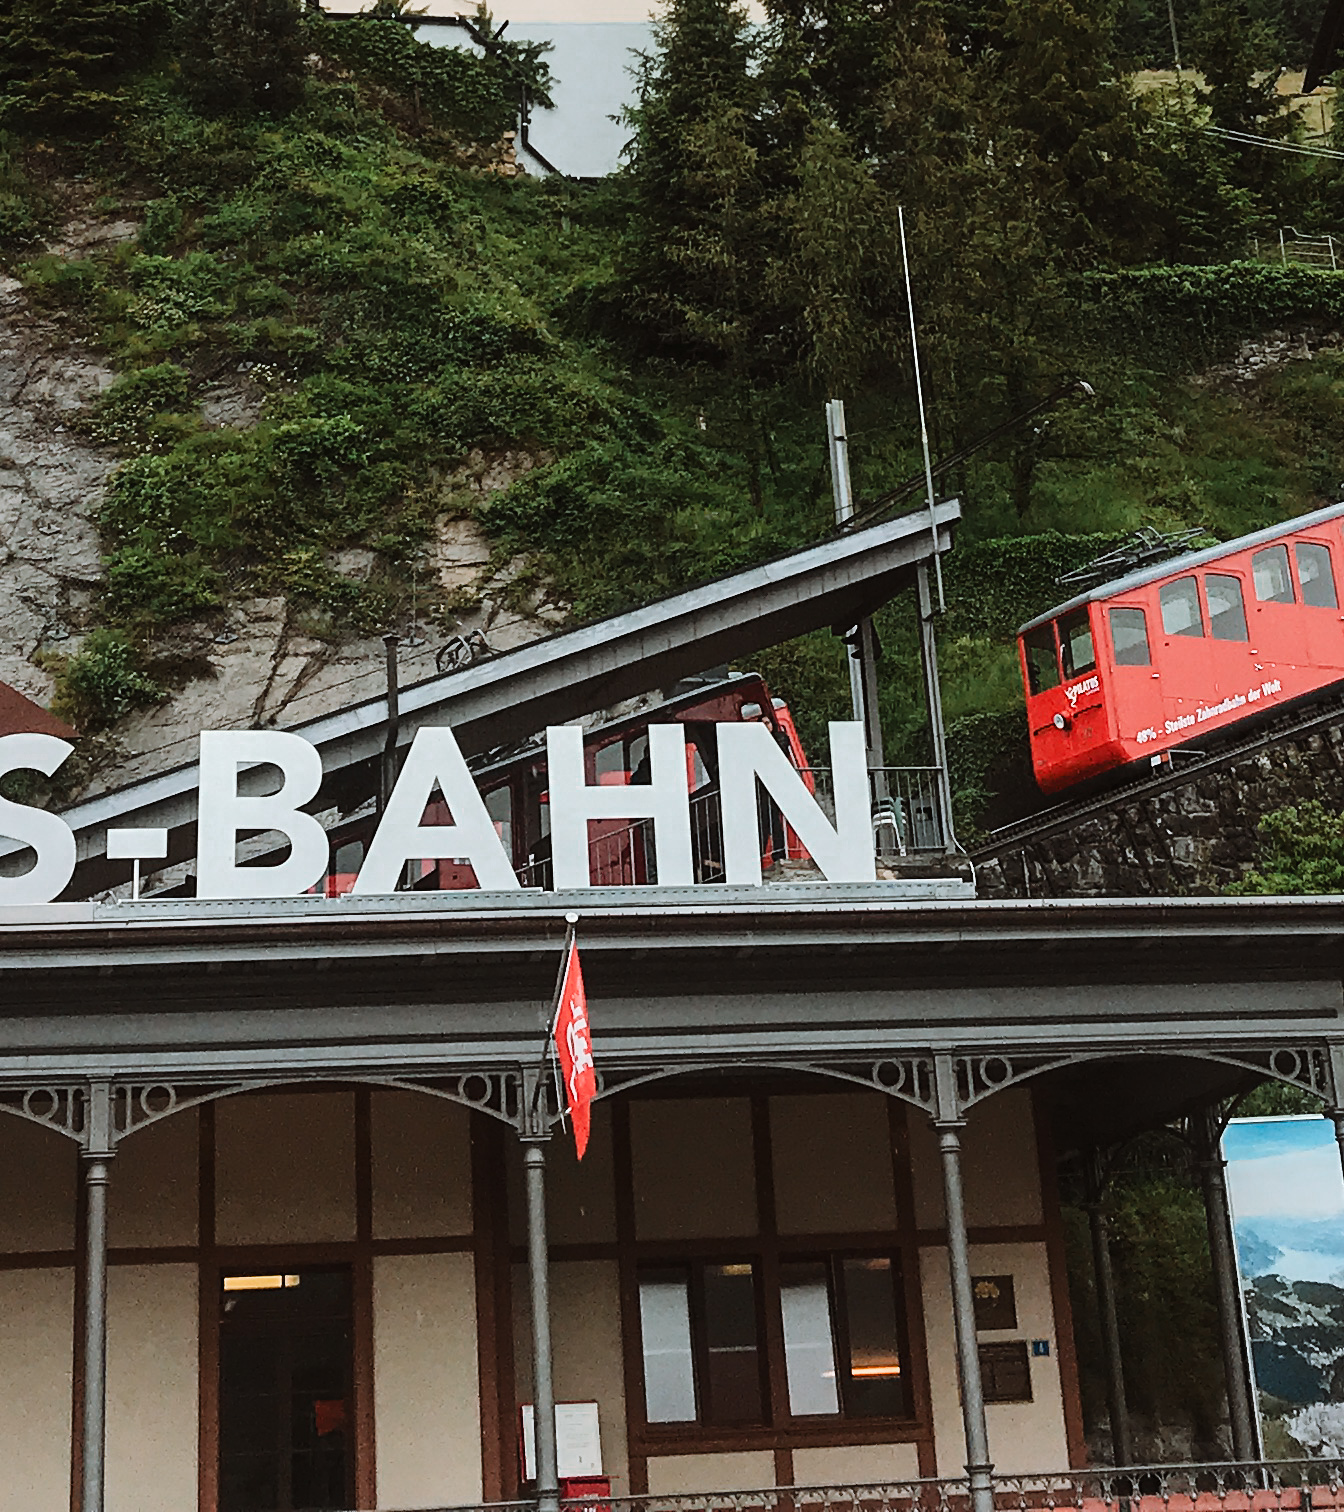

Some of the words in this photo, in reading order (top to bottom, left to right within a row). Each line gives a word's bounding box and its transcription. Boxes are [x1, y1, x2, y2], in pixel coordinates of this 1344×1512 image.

[1072, 675, 1099, 695] PILATUS
[1136, 726, 1157, 744] 48%
[1164, 714, 1196, 735] Steilste
[1196, 694, 1247, 723] Zahnradbahn
[1248, 688, 1261, 703] der
[1261, 679, 1282, 697] Welt
